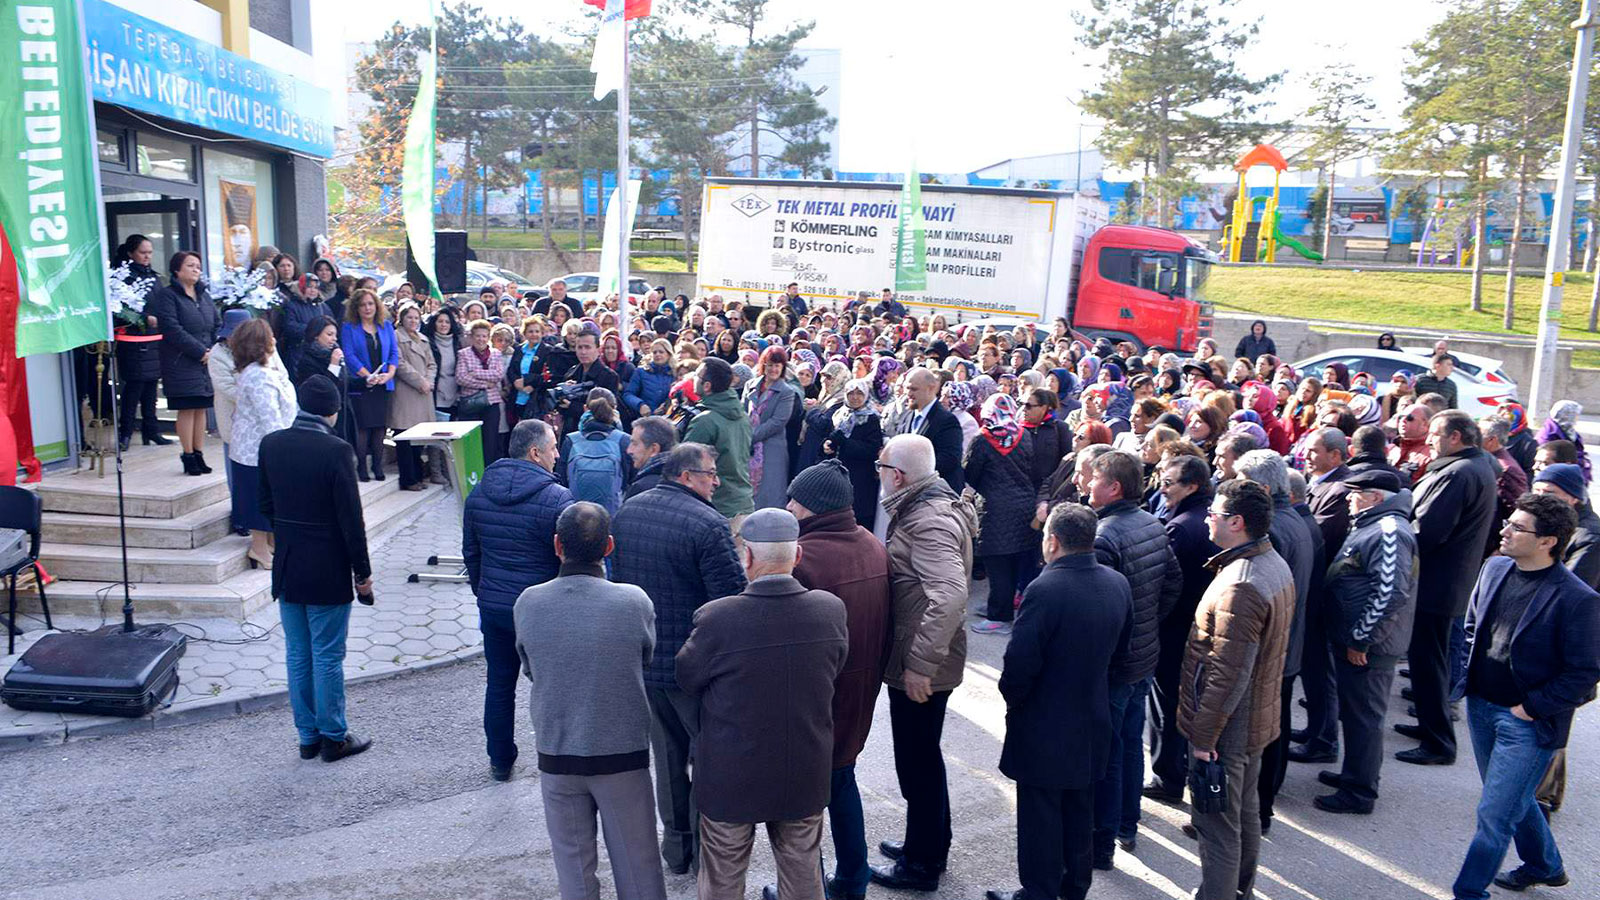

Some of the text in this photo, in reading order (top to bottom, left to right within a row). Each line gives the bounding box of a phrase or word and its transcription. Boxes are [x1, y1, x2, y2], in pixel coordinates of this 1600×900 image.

[253, 100, 299, 138] BELDE
[740, 198, 762, 209] TEK
[777, 199, 956, 222] TEK METAL PROFİL NAYİ
[790, 219, 878, 237] KÖMMERLING
[945, 228, 1013, 245] KİMYASALLARI
[789, 238, 875, 255] Bystronic glass
[925, 246, 1001, 262] AM MAKİNALARI
[941, 263, 996, 278] PROFİLLERİ
[722, 278, 733, 287] TEL
[922, 295, 1016, 311] tekmetal@tek-metal.com
